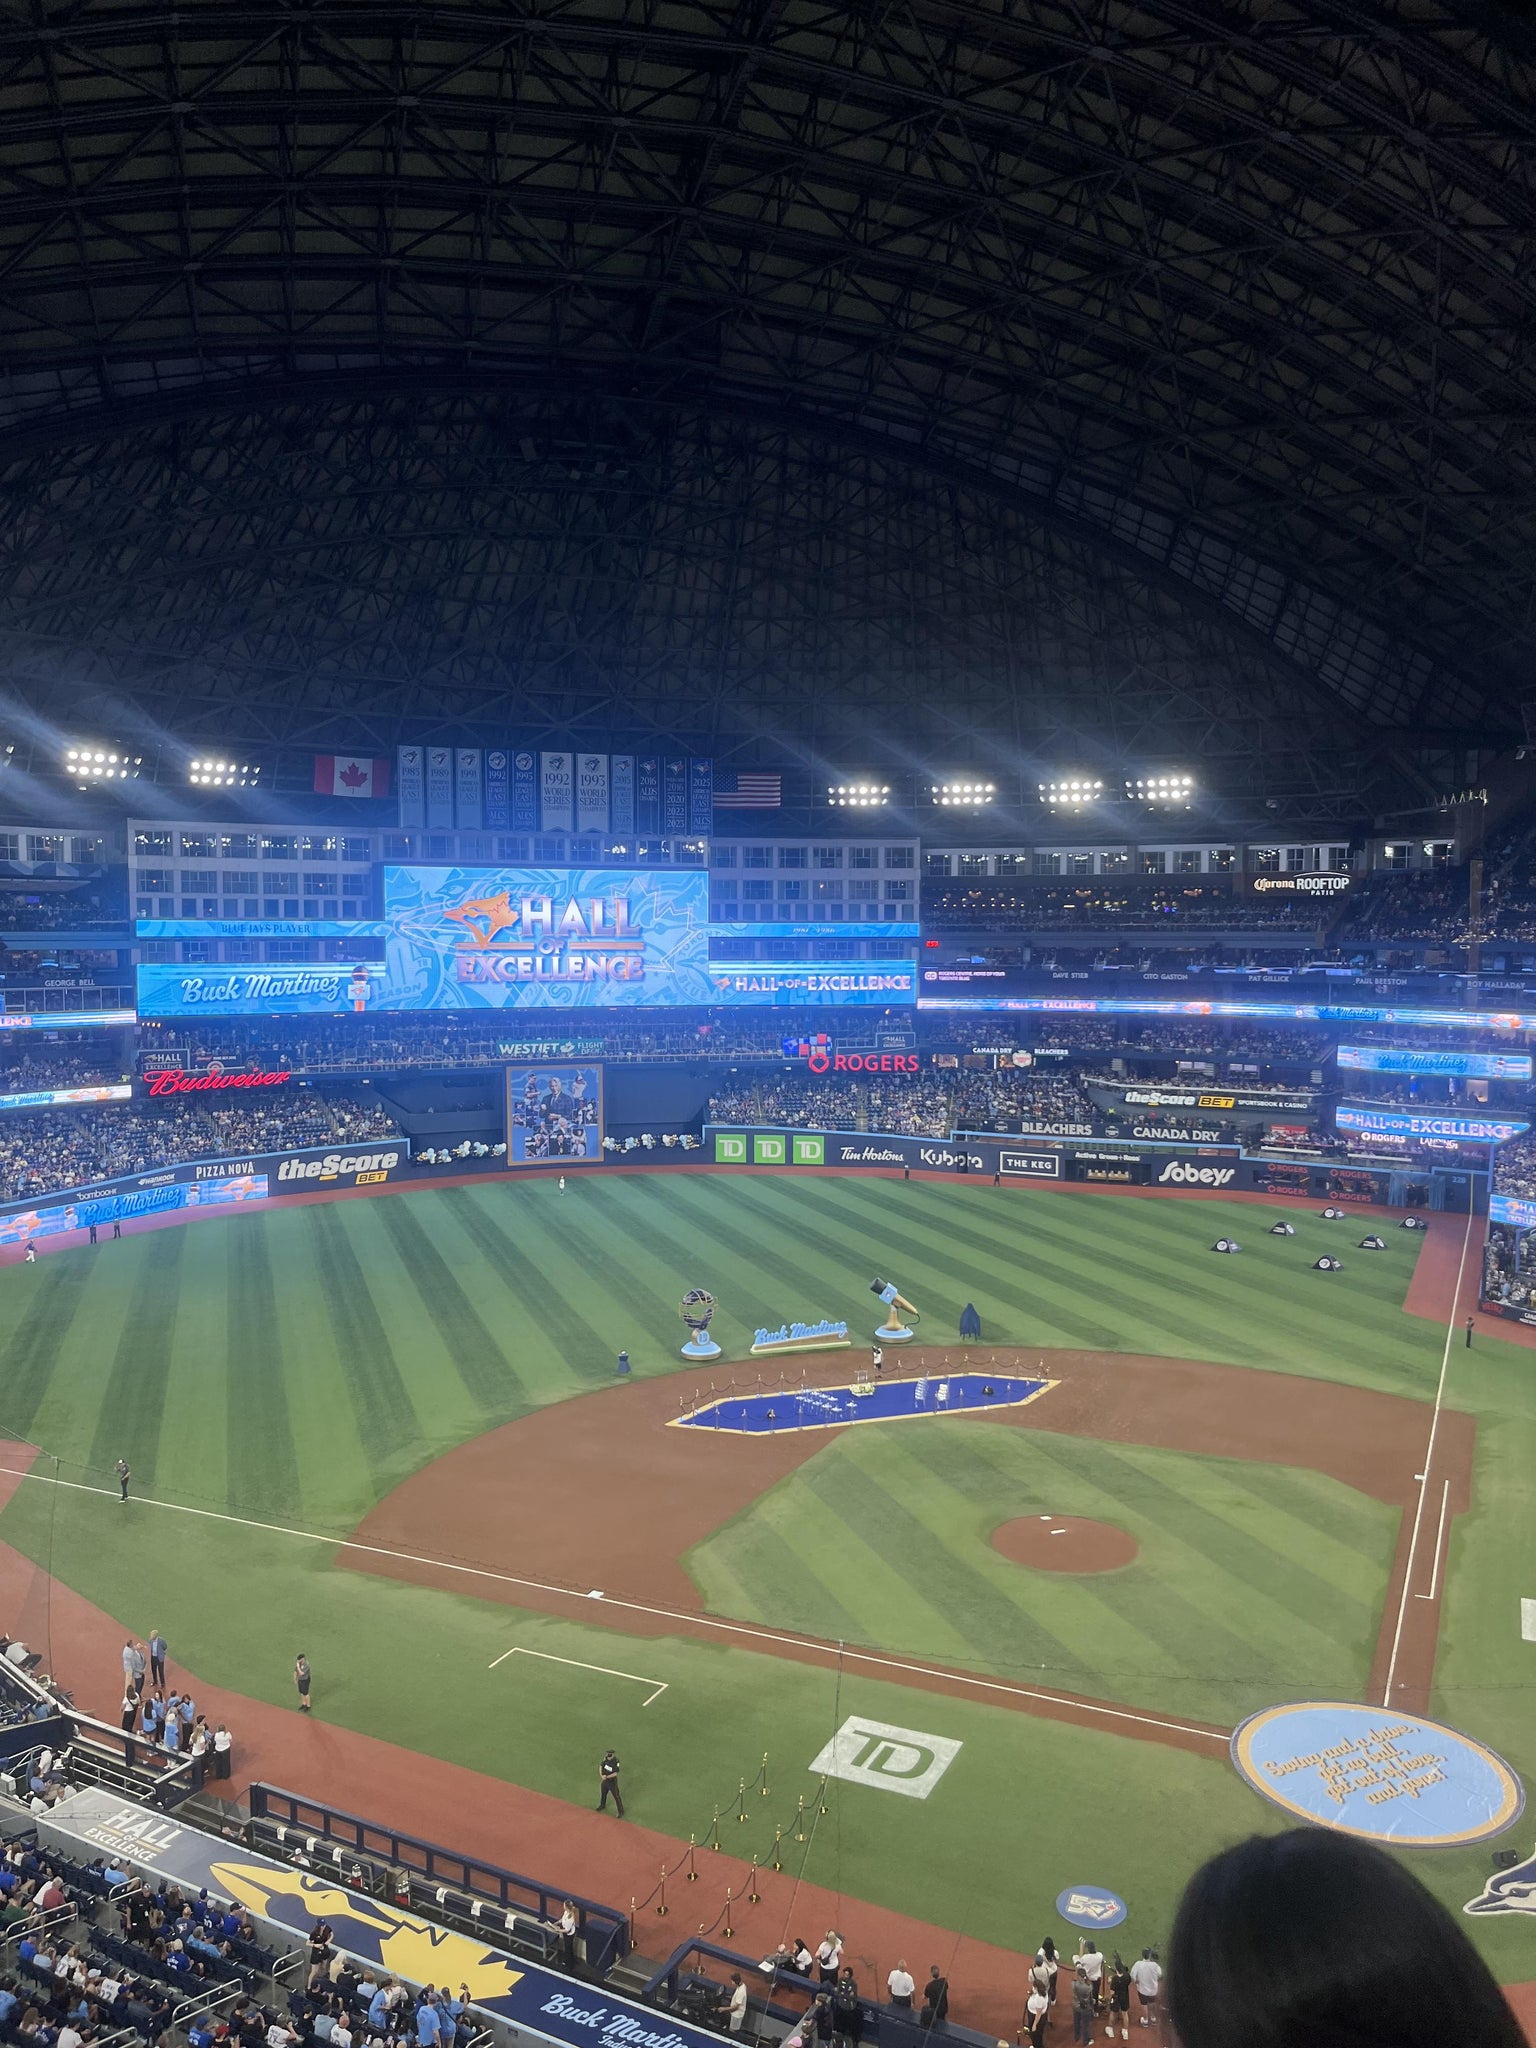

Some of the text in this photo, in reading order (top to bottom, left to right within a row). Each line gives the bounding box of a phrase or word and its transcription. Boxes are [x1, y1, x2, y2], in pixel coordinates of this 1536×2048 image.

[431, 769, 449, 777] 1989
[460, 770, 477, 778] 1991
[488, 771, 506, 779] 1992
[545, 773, 570, 786] 1992
[580, 774, 606, 786] 1993
[640, 777, 657, 785] 2016
[693, 778, 711, 787] 2025
[544, 787, 571, 796] WORLD
[579, 788, 607, 797] WORLD
[543, 796, 571, 805] SERIES
[579, 797, 607, 806] SERIES
[666, 795, 685, 803] 2020
[666, 807, 685, 815] 2022
[666, 819, 685, 828] 2023
[1253, 877, 1350, 891] Corona ROOFTOP
[519, 895, 641, 937] HALL
[221, 924, 311, 934] BLUE JAYS PLAYER
[538, 940, 565, 955] OF
[456, 956, 644, 982] EXCELLENCE
[44, 978, 95, 987] GEORGE BELL
[735, 976, 779, 992] HALL
[807, 975, 911, 991] EXCELLENCE
[1160, 973, 1188, 981] GASTON
[1355, 977, 1408, 986] PAUL BEESTON
[181, 972, 341, 1003] Buck Martinez
[1467, 980, 1526, 990] ROY HALLADAY
[577, 1041, 604, 1049] FLIGHT
[157, 1053, 182, 1062] HALL
[834, 1054, 919, 1072] ROGERS
[1410, 1054, 1467, 1072] Martinez
[143, 1067, 291, 1096] Budweiser
[1124, 1091, 1195, 1106] theScore
[1200, 1097, 1233, 1107] BET
[1238, 1099, 1278, 1107] SPORTSBOOK
[1021, 1122, 1092, 1136] BLEACHERS
[1356, 1114, 1386, 1129] HALL
[1411, 1119, 1514, 1139] EXCELLENCE
[1133, 1127, 1189, 1140] CANADA
[1371, 1133, 1406, 1143] ROGERS
[719, 1139, 743, 1157] TD
[757, 1140, 782, 1158] TD
[796, 1141, 821, 1159] TD
[840, 1146, 904, 1161] Tim Hortons
[920, 1148, 983, 1169] Kubota
[1006, 1158, 1053, 1170] THE KEG
[196, 1161, 255, 1179] PIZZA NOVA
[278, 1152, 399, 1181] theScore
[1276, 1164, 1309, 1174] ROGERS
[358, 1171, 386, 1184] BET
[1158, 1161, 1235, 1186] Sobeys
[1339, 1170, 1372, 1180] ROGERS
[1276, 1186, 1308, 1196] ROGERS
[1339, 1192, 1372, 1202] ROGERS
[84, 1188, 181, 1224] Buck Martinez
[755, 1319, 849, 1346] Buck Martinez
[850, 1729, 936, 1779] TD
[1262, 1752, 1324, 1777] Swing
[1322, 1736, 1359, 1759] and
[1355, 1737, 1373, 1748] a
[1365, 1779, 1404, 1805] and
[103, 1808, 183, 1850] HALL
[122, 1832, 138, 1843] OF
[84, 1827, 158, 1862] EXCELLENCE
[539, 1993, 609, 2028] Buck
